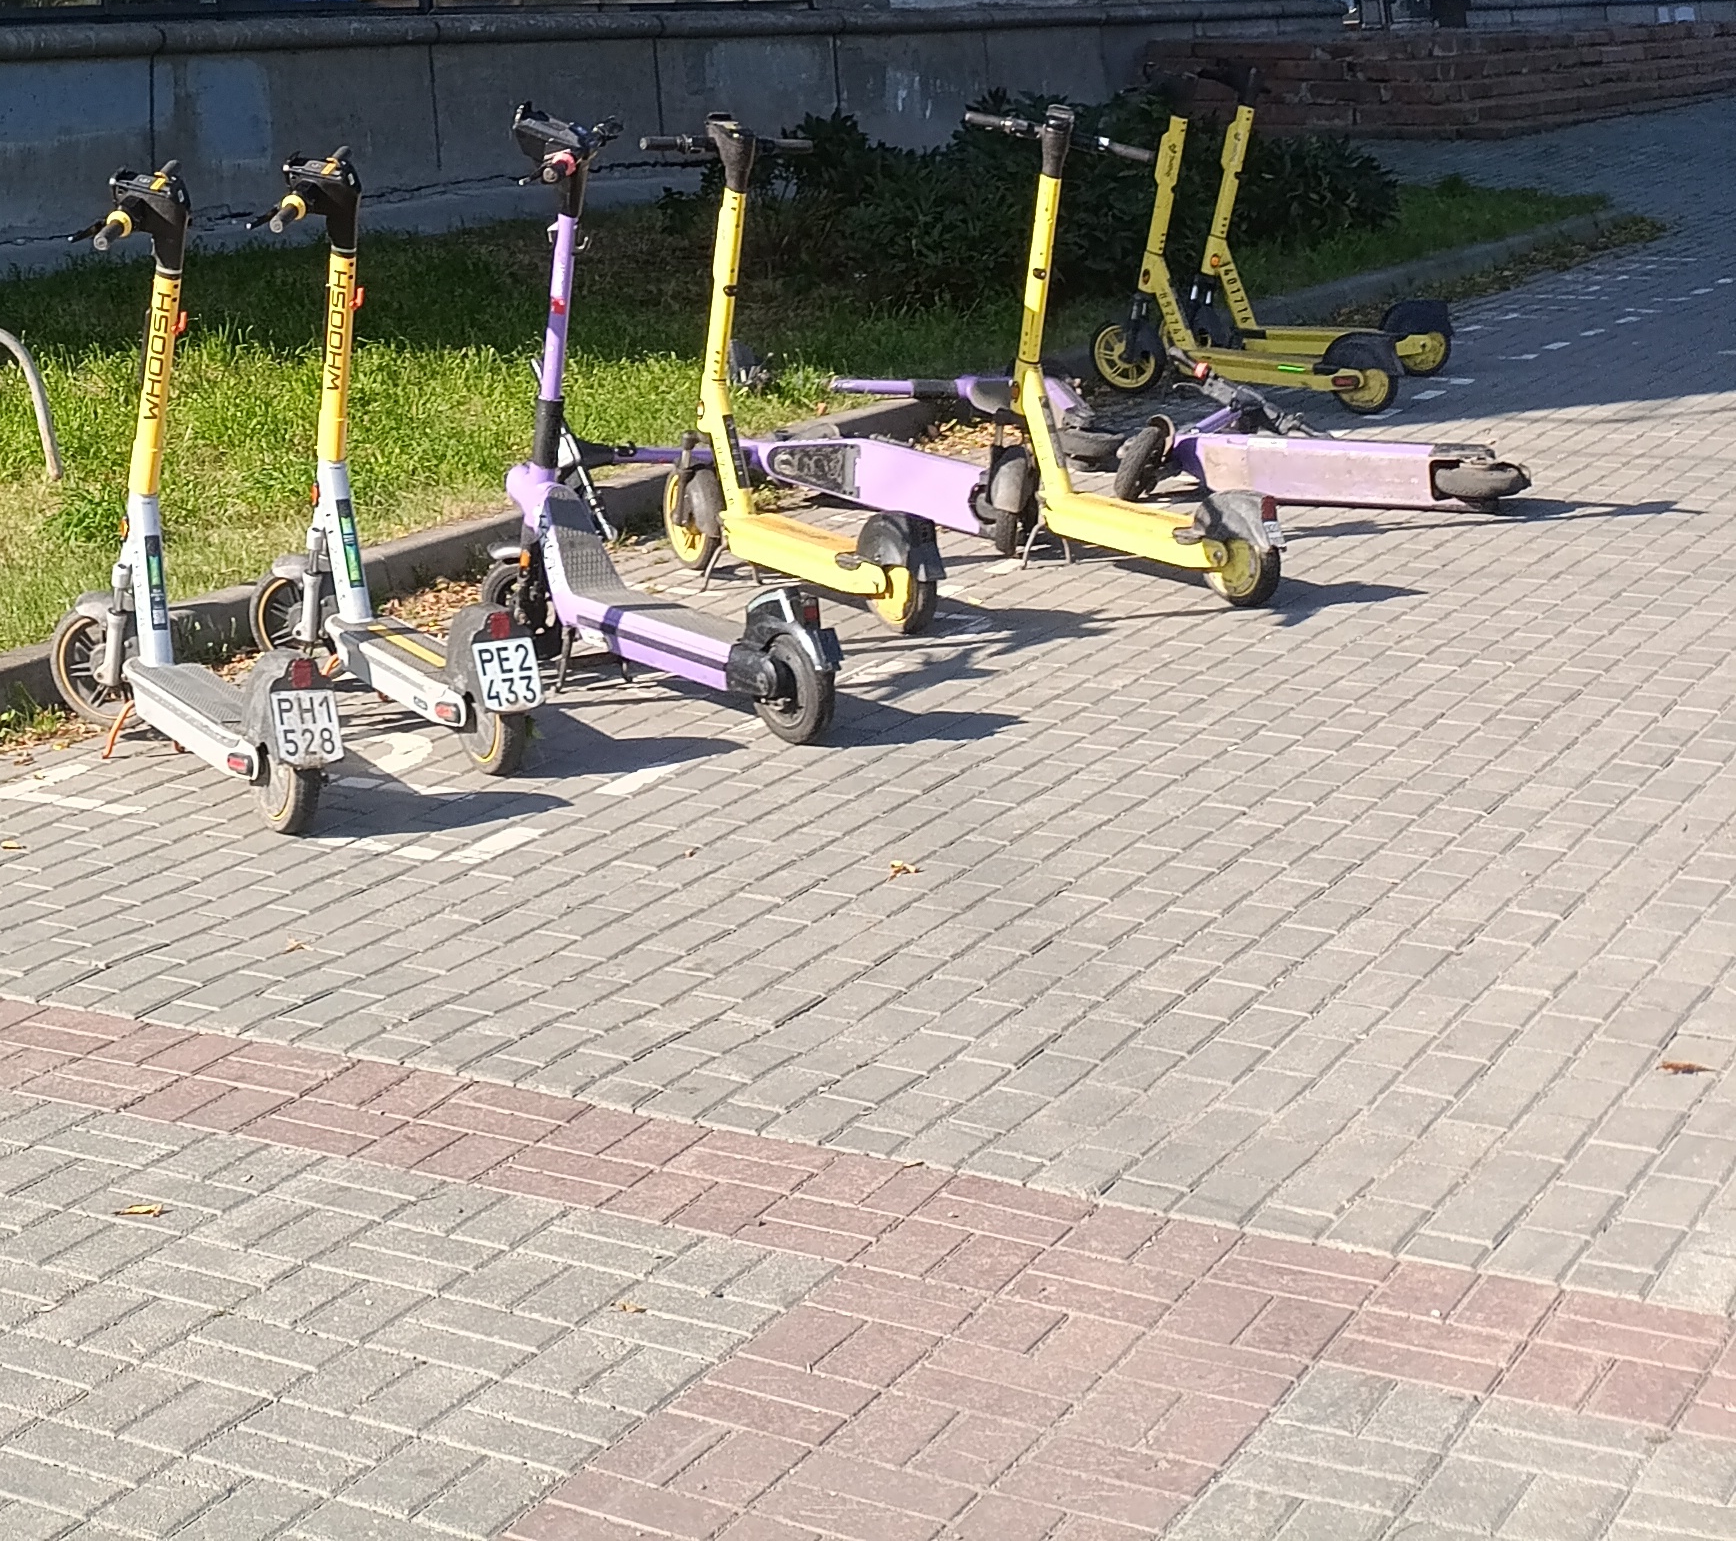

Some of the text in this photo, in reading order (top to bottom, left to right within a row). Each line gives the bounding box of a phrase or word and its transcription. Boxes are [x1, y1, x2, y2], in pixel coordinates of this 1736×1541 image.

[143, 291, 172, 421] WHOOSH
[326, 269, 348, 391] WHOOSH
[486, 675, 537, 708] 433
[283, 727, 336, 757] 528
